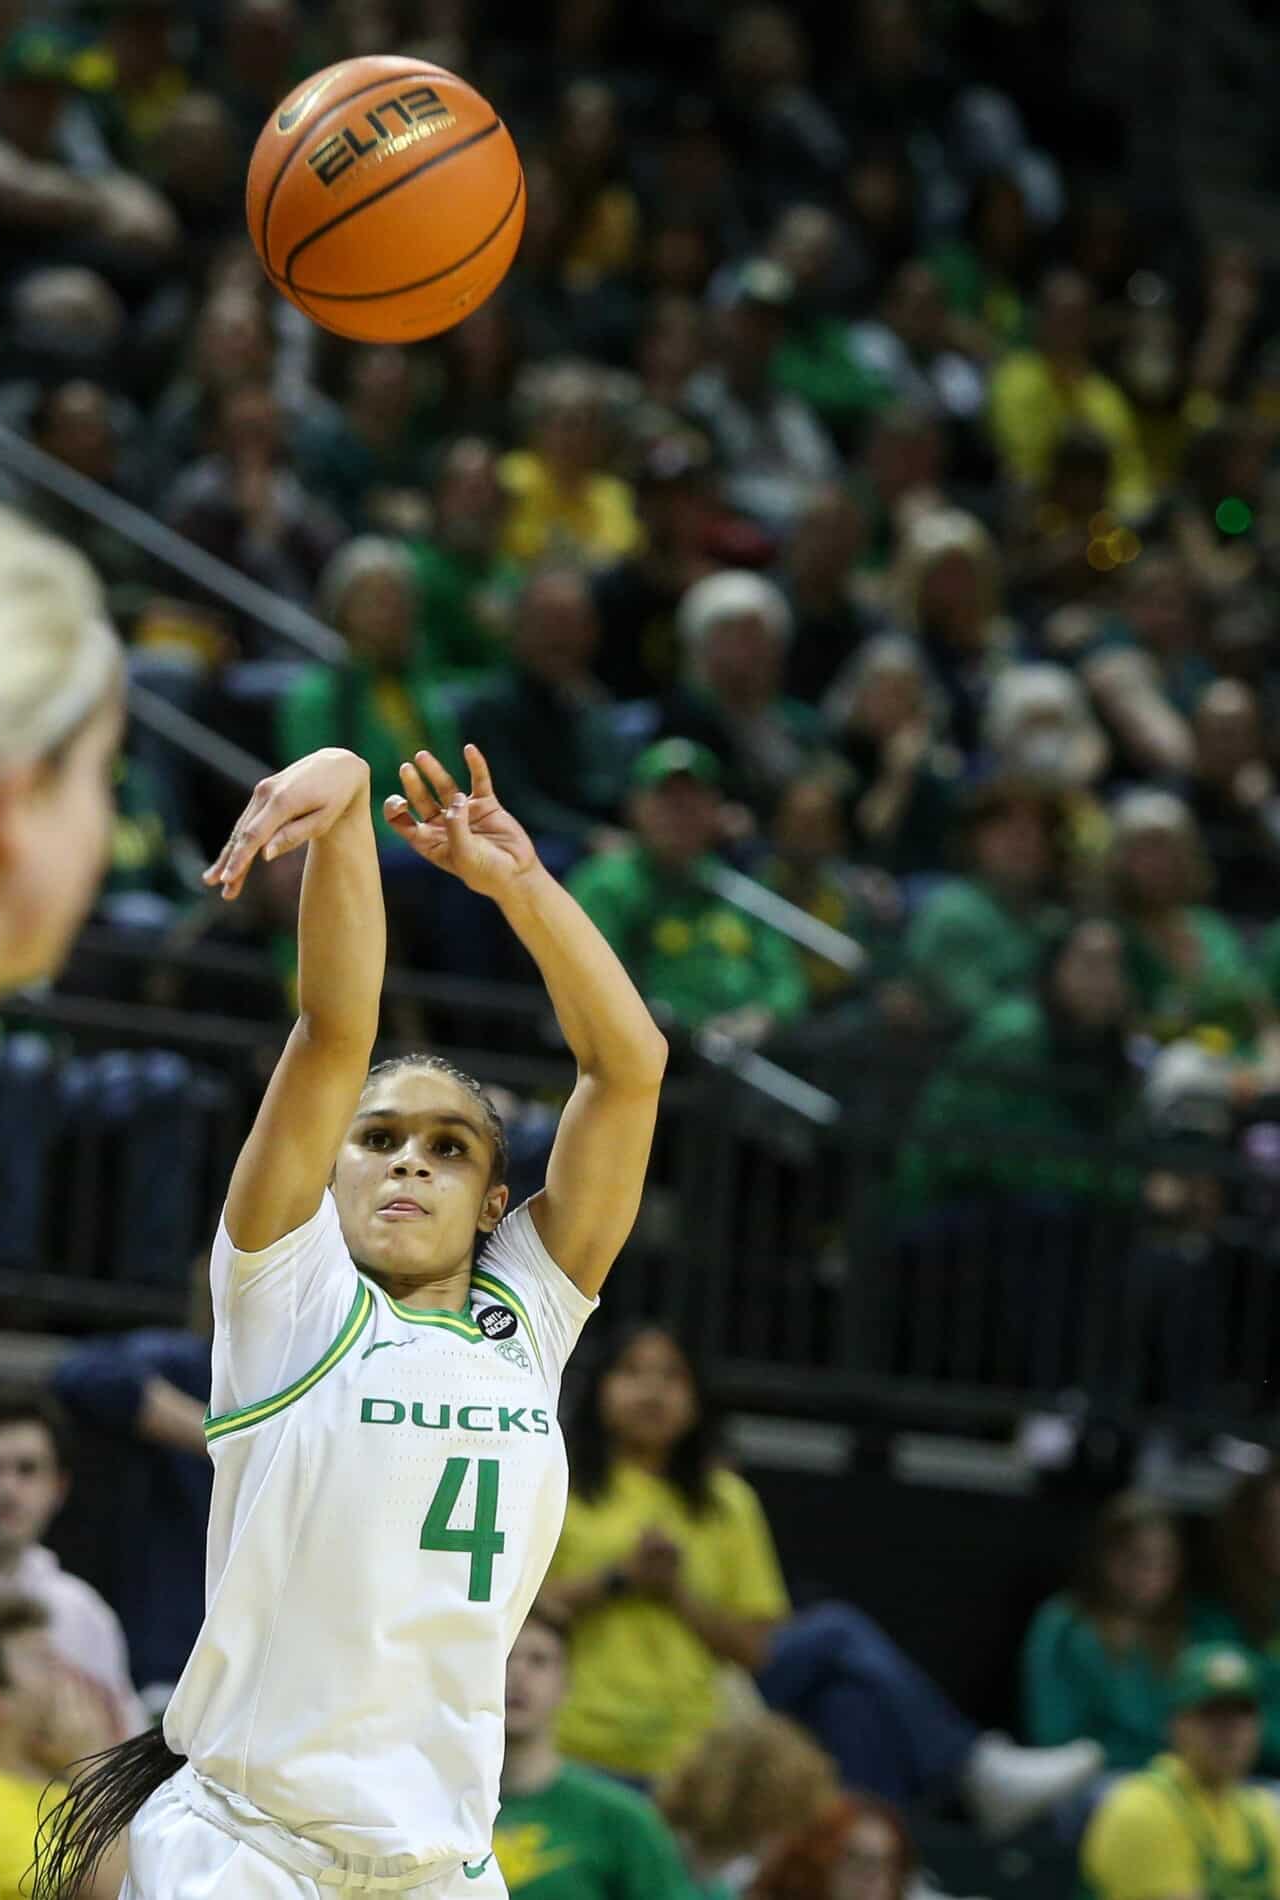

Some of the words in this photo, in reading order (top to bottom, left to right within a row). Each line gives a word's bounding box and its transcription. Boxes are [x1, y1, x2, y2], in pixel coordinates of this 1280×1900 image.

[306, 87, 449, 187] ELITE
[481, 1311, 504, 1328] ANTI-
[485, 1313, 515, 1336] RACISM
[360, 1397, 550, 1435] DUCKS
[419, 1457, 505, 1602] 4
